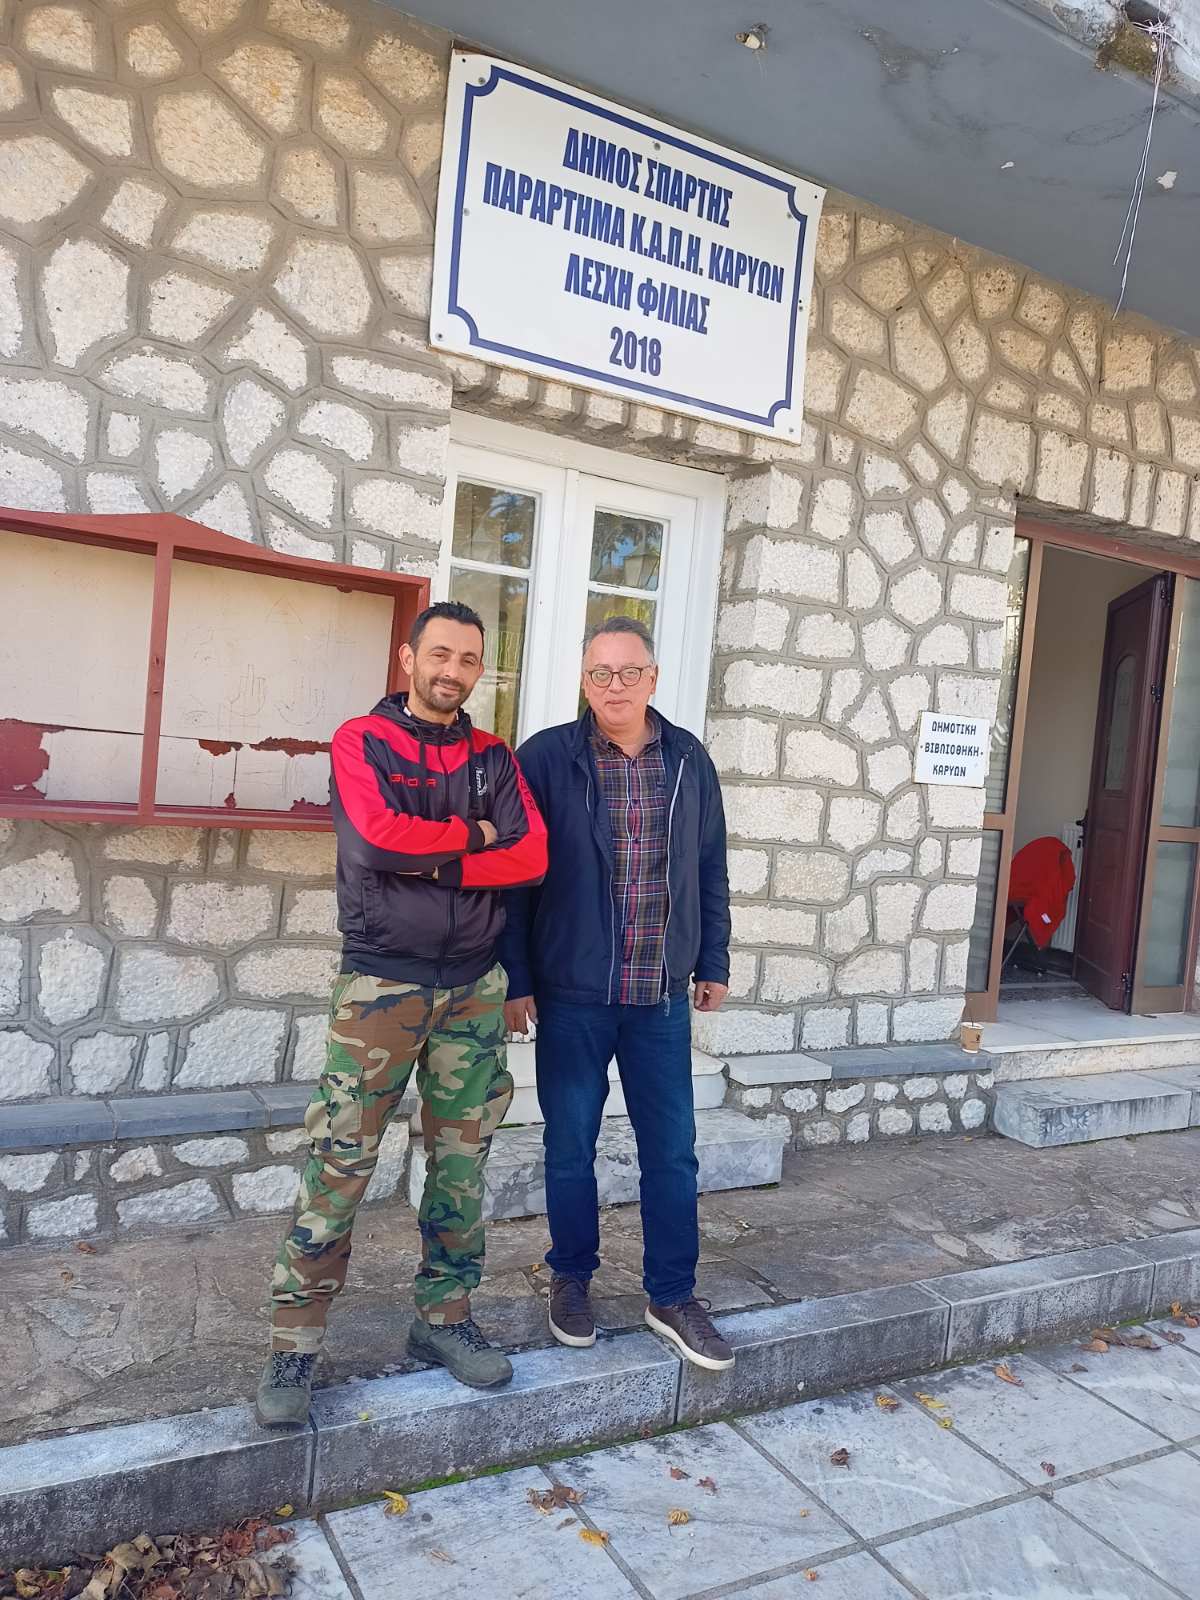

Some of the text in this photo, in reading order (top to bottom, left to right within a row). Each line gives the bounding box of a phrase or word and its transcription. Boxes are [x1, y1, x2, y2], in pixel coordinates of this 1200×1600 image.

[562, 127, 733, 228] ΔΗΜΟΣ ΣΠΑΡΤΗΣ
[482, 161, 785, 303] ΠΑΡΑΡΤΗΜΑ Κ.Α.Π.Η. ΚΑΡΥΩΝ
[564, 253, 710, 335] ΛΕΣΧΗ ΦΙΛΙΑΣ
[609, 326, 661, 377] 2018
[924, 742, 979, 757] ΒΙΒΛΙΟΘΗΚΗ
[931, 720, 977, 735] ΔΗΜΟΤΙΚΗ
[932, 764, 967, 777] ΚΑΡΥΩΝ
